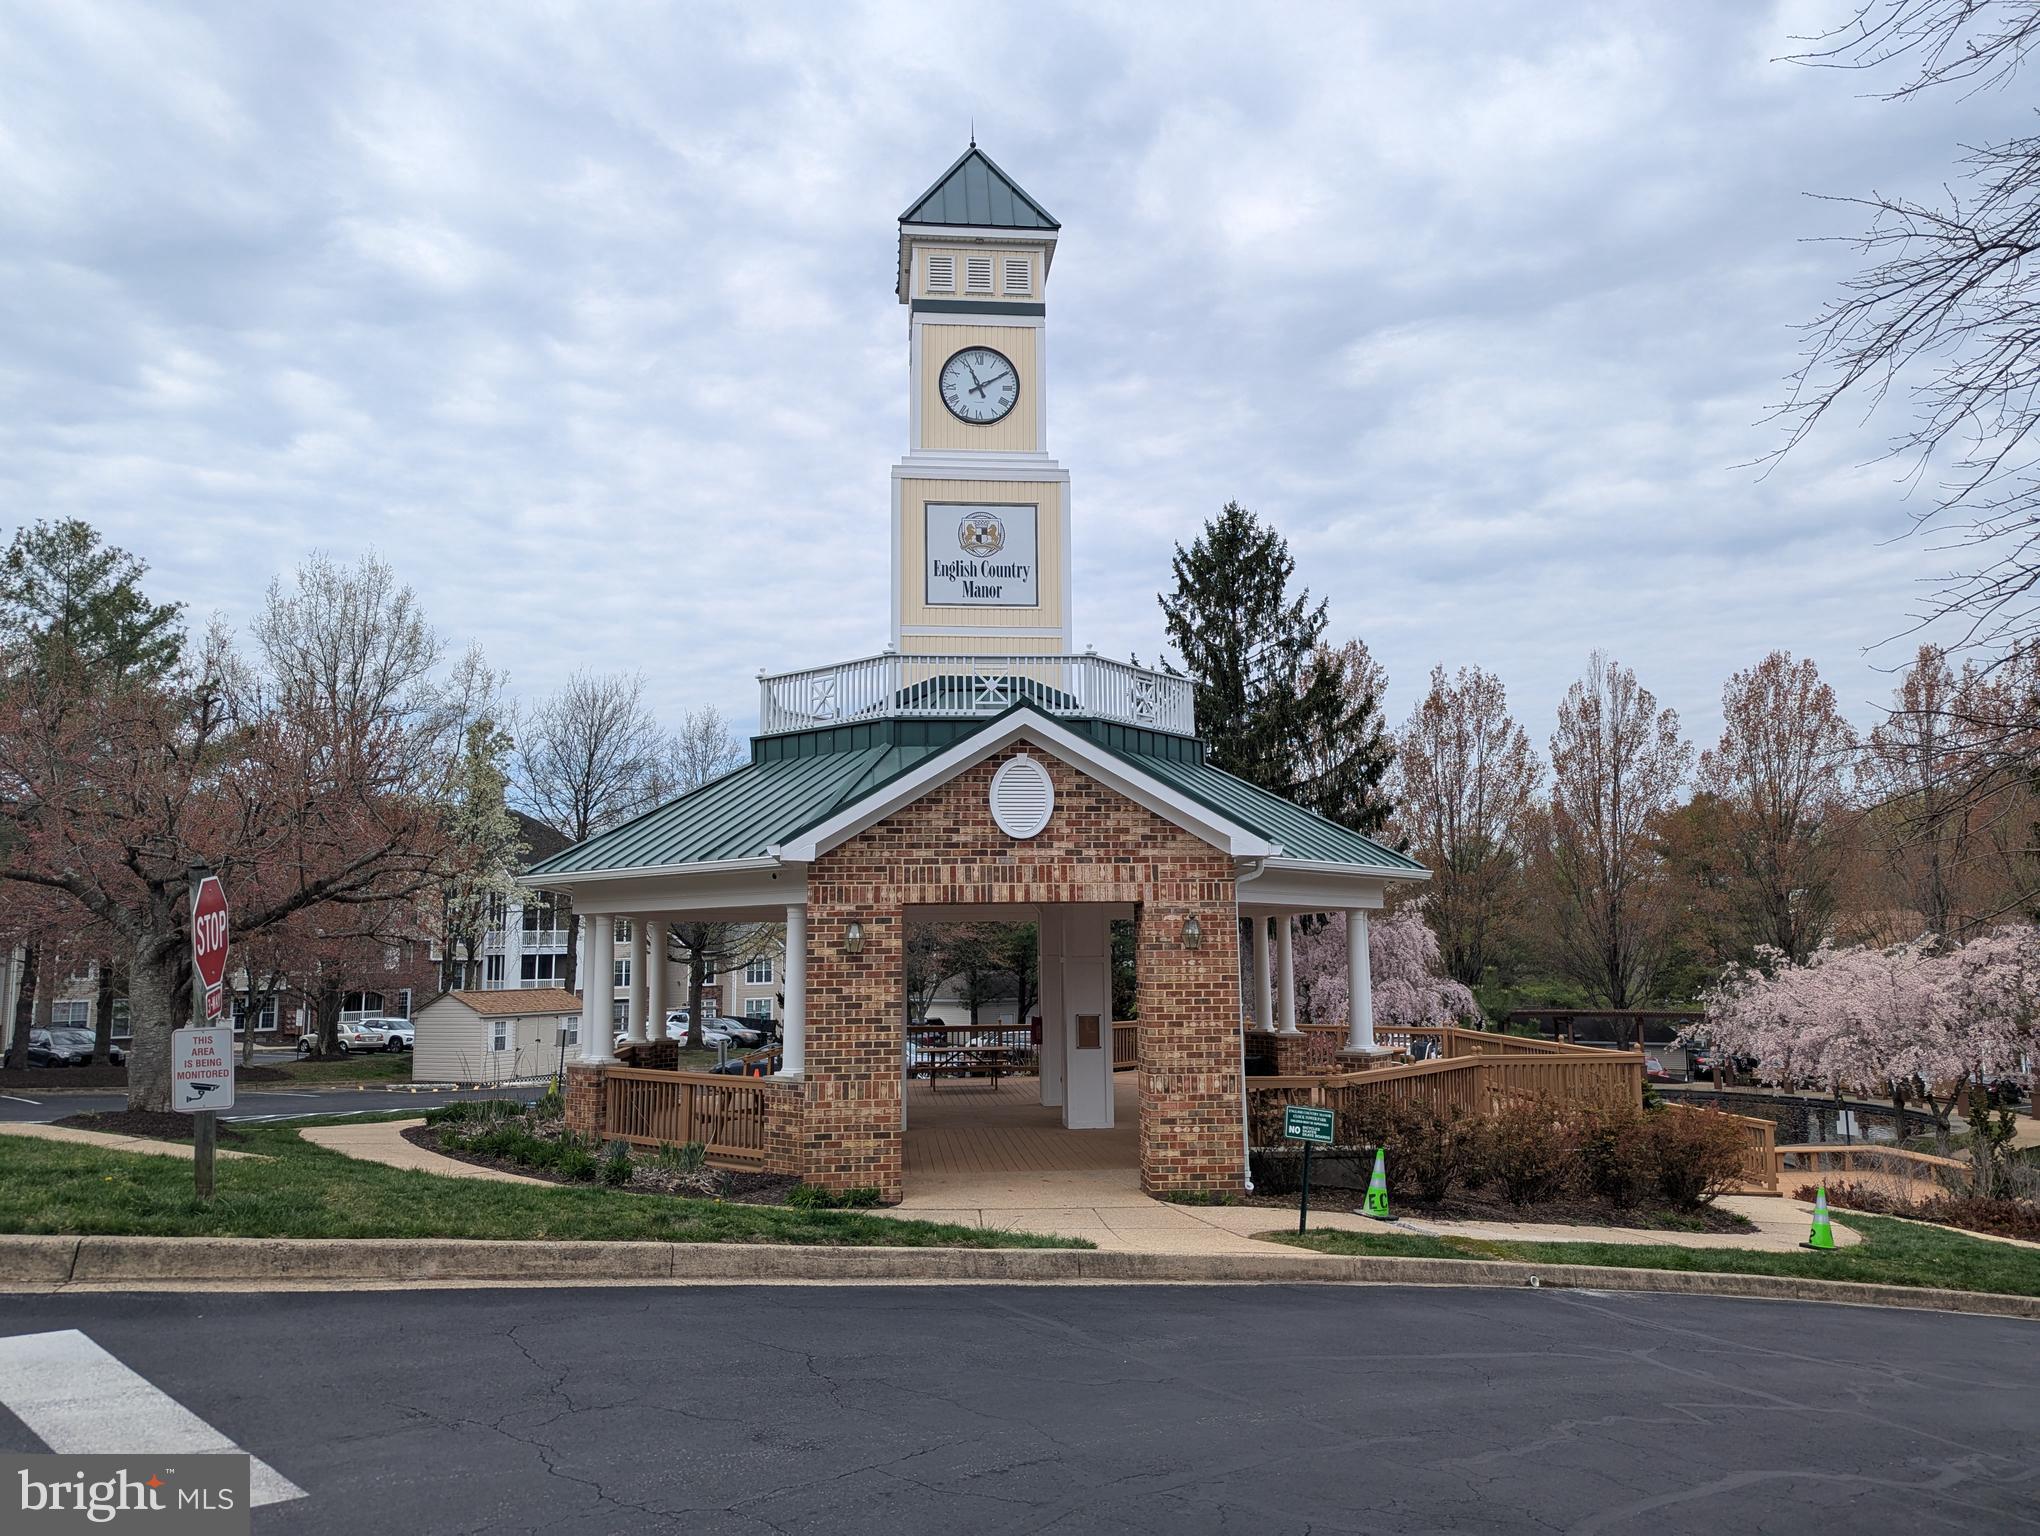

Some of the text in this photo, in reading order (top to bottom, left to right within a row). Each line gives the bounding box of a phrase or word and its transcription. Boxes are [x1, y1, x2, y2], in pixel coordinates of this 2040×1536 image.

[975, 354, 984, 365] XII
[950, 369, 960, 377] X
[933, 560, 1030, 583] English Country
[962, 580, 1002, 599] Manor
[197, 910, 226, 956] STOP
[192, 1036, 213, 1044] THIS
[191, 1047, 215, 1056] AREA
[184, 1058, 222, 1068] IS BEING
[177, 1070, 229, 1080] MONITORED
[1288, 1125, 1300, 1134] NO
